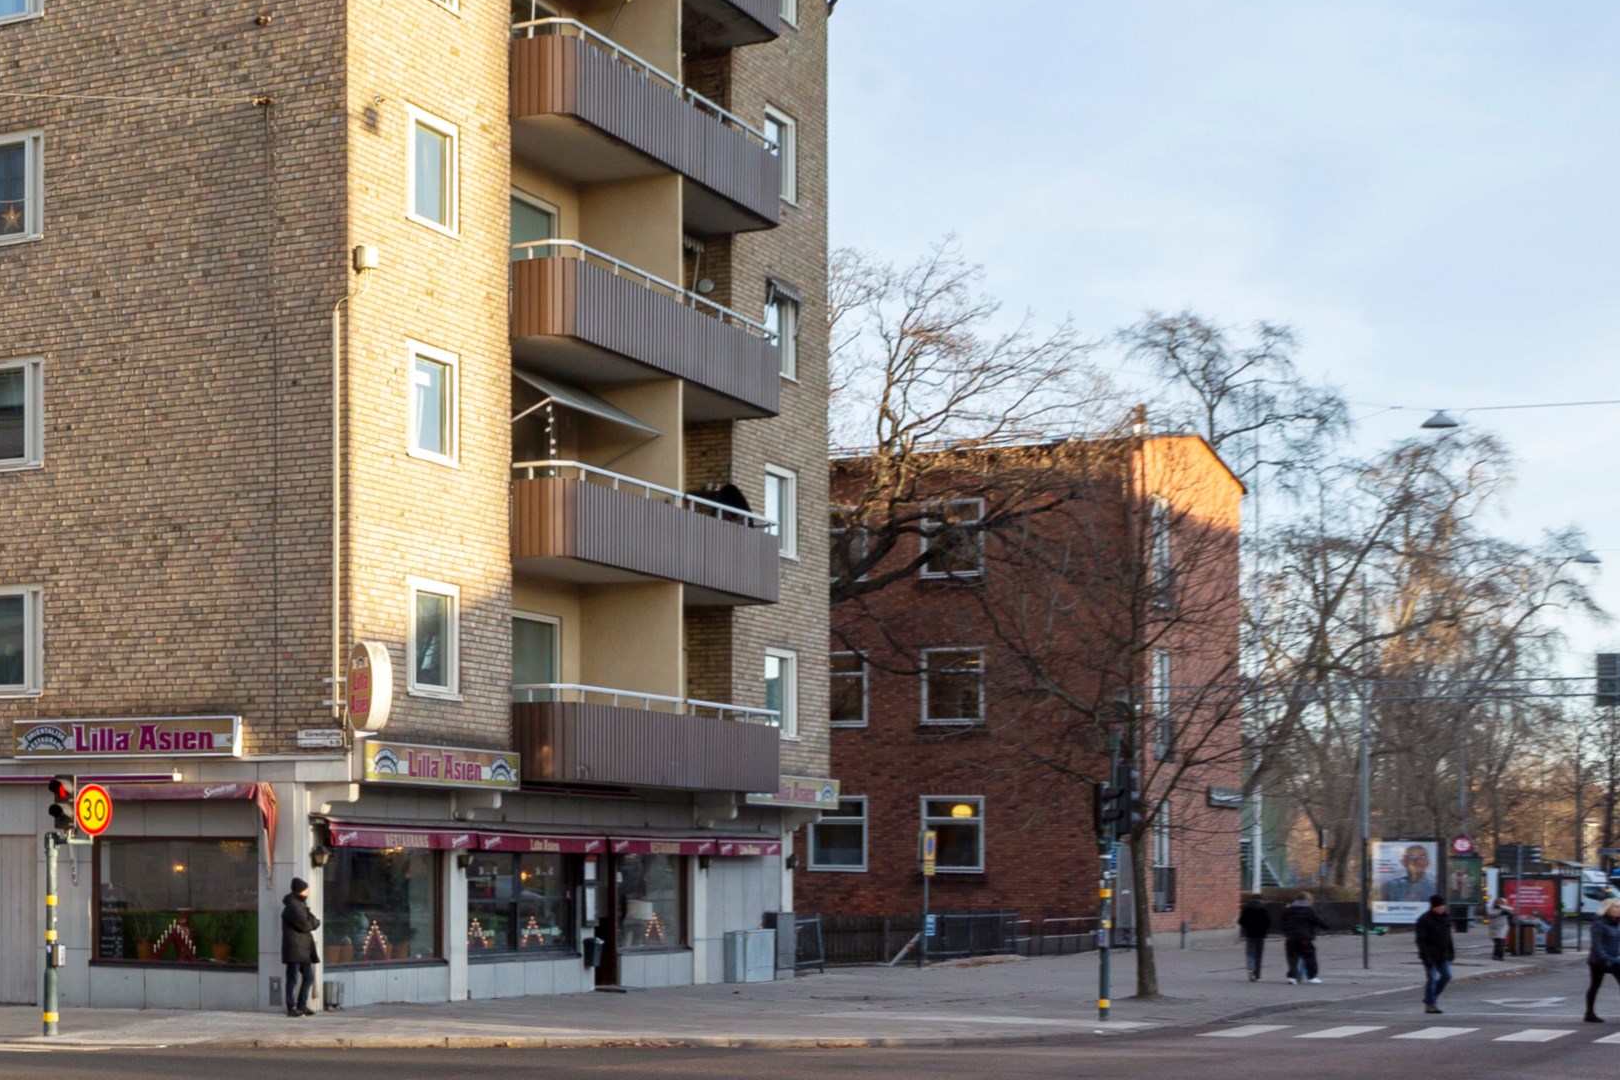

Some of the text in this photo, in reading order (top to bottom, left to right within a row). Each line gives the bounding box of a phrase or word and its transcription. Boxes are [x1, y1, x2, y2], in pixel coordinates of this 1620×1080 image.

[352, 671, 368, 691] Lilla
[25, 726, 66, 741] ORIENTALISK
[72, 722, 215, 752] Lilla Asien
[406, 748, 441, 779] Lilla
[442, 750, 483, 782] Asien
[83, 798, 106, 822] 30
[384, 833, 429, 849] RESTAURANG
